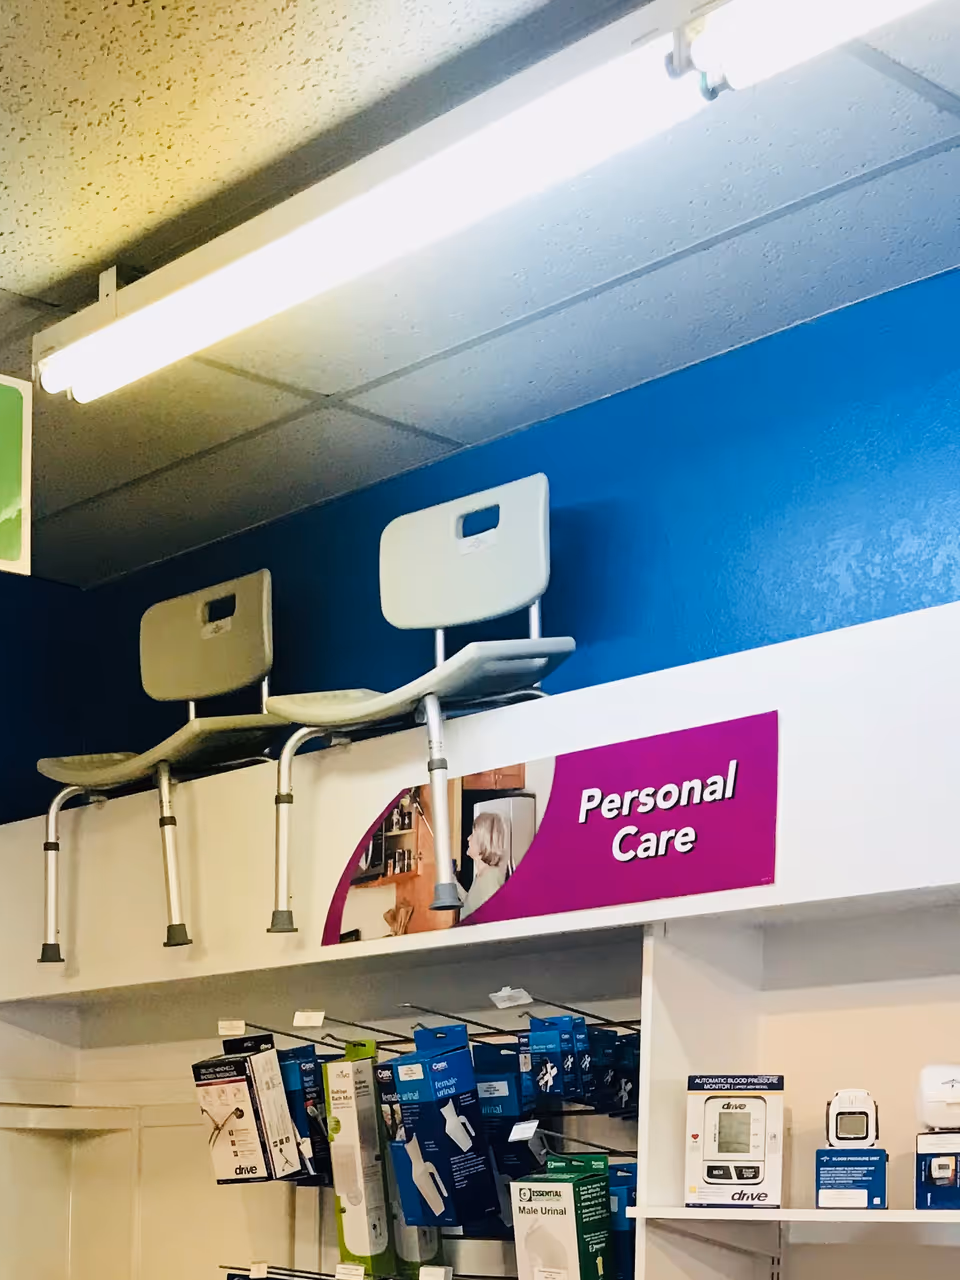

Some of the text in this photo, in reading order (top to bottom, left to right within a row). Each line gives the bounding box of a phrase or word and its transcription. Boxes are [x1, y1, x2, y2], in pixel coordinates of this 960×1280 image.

[578, 759, 739, 824] Personal
[611, 825, 697, 863] Care
[435, 1077, 458, 1089] female
[381, 1090, 419, 1102] female urinal
[436, 1086, 456, 1098] urinal
[721, 1102, 746, 1110] drive
[234, 1165, 258, 1176] drive
[531, 1189, 562, 1197] ESSENTIAL
[731, 1190, 769, 1202] drive
[518, 1206, 567, 1216] Male Urinal
